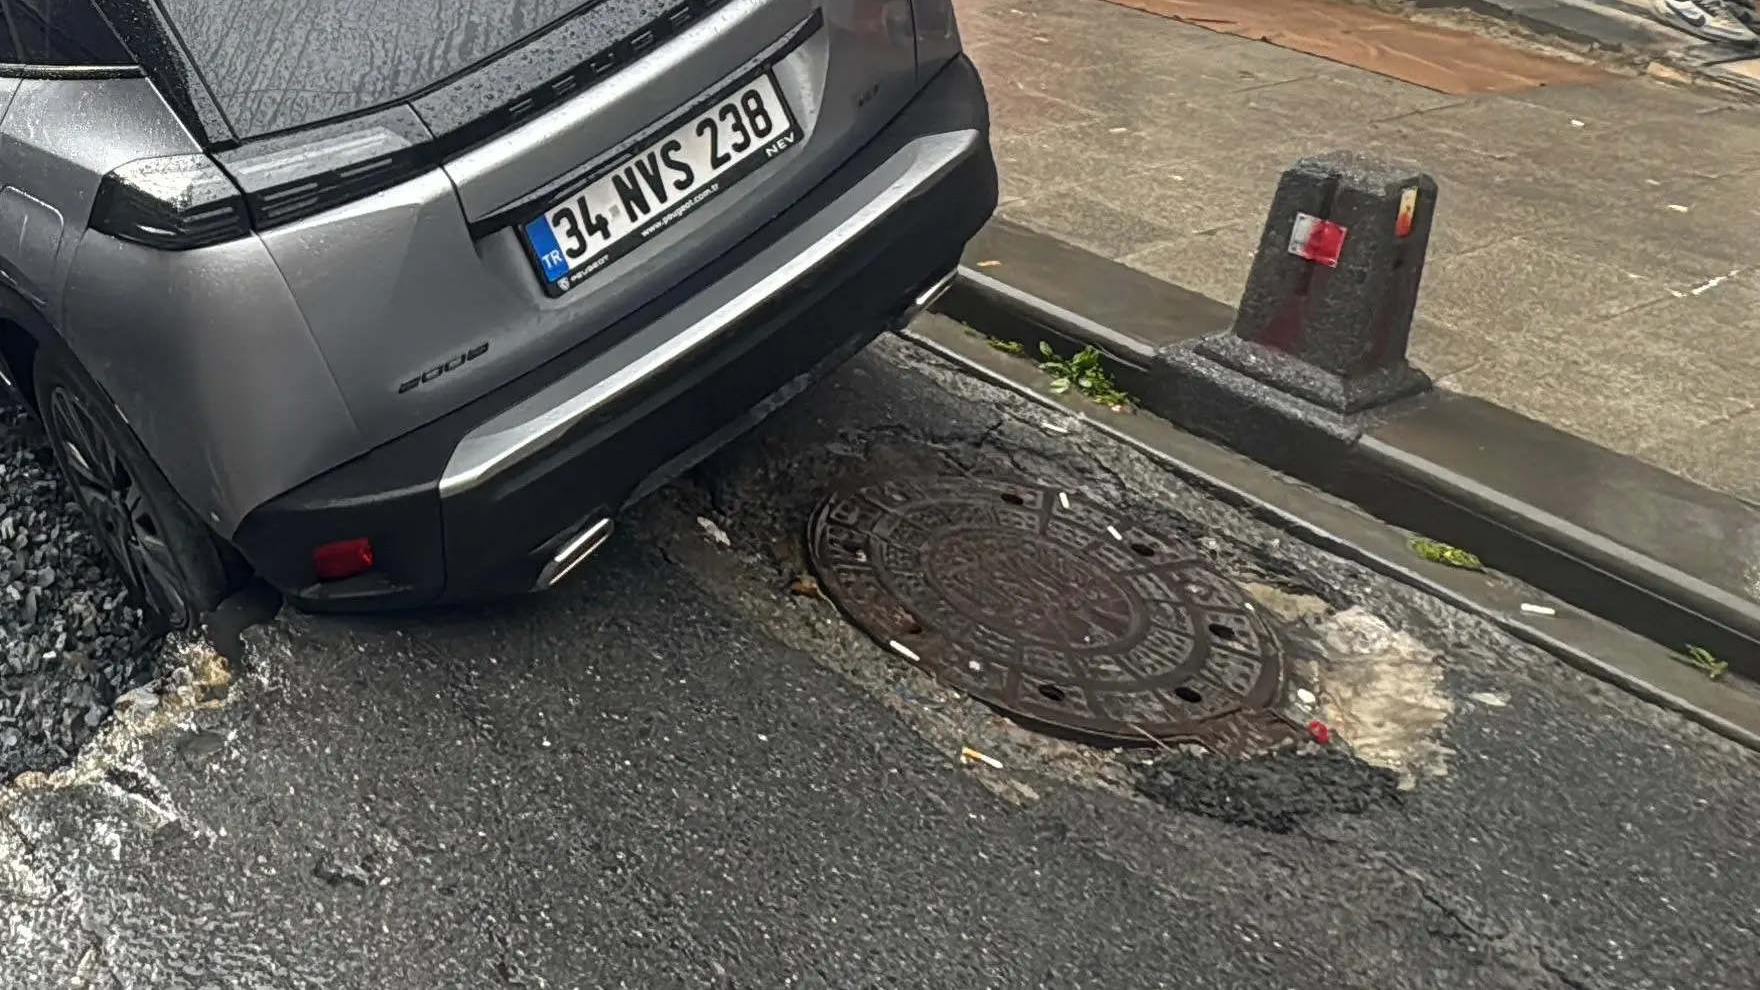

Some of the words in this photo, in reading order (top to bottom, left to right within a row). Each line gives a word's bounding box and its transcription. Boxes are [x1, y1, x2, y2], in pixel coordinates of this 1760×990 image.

[695, 88, 774, 171] 238
[764, 131, 796, 159] NEV
[611, 138, 696, 223] NVS
[541, 249, 563, 269] TR
[551, 195, 611, 259] 34
